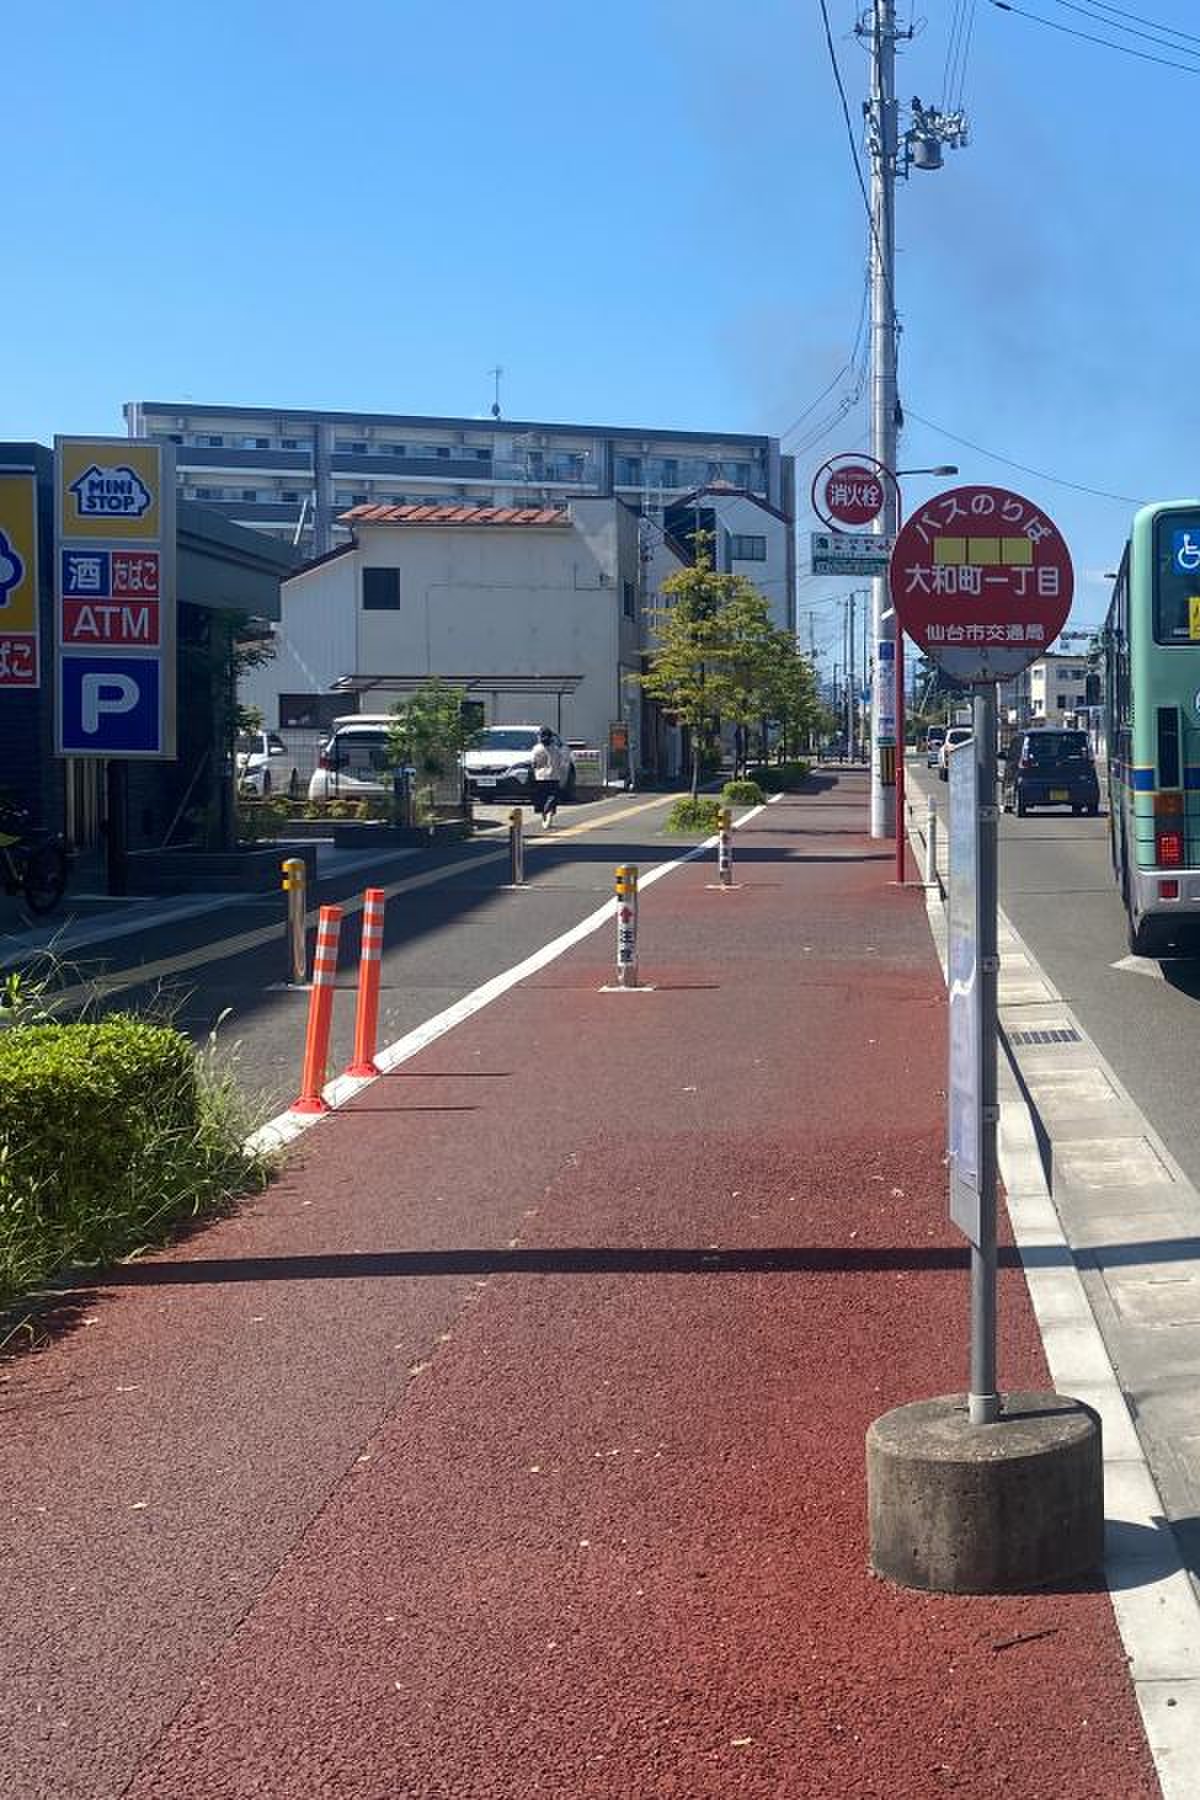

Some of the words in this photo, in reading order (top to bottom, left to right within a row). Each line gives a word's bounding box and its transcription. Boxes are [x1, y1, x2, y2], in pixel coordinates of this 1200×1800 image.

[87, 495, 135, 511] STOP
[88, 479, 133, 495] MINI
[831, 483, 880, 507] 消火栓
[915, 494, 1053, 544] バスのりば
[68, 557, 103, 590] 酒
[113, 559, 158, 591] たばこ
[905, 563, 1059, 596] 大和町一丁目
[73, 605, 150, 639] ATM
[926, 623, 1045, 641] 仙台市交通局
[80, 673, 141, 734] P
